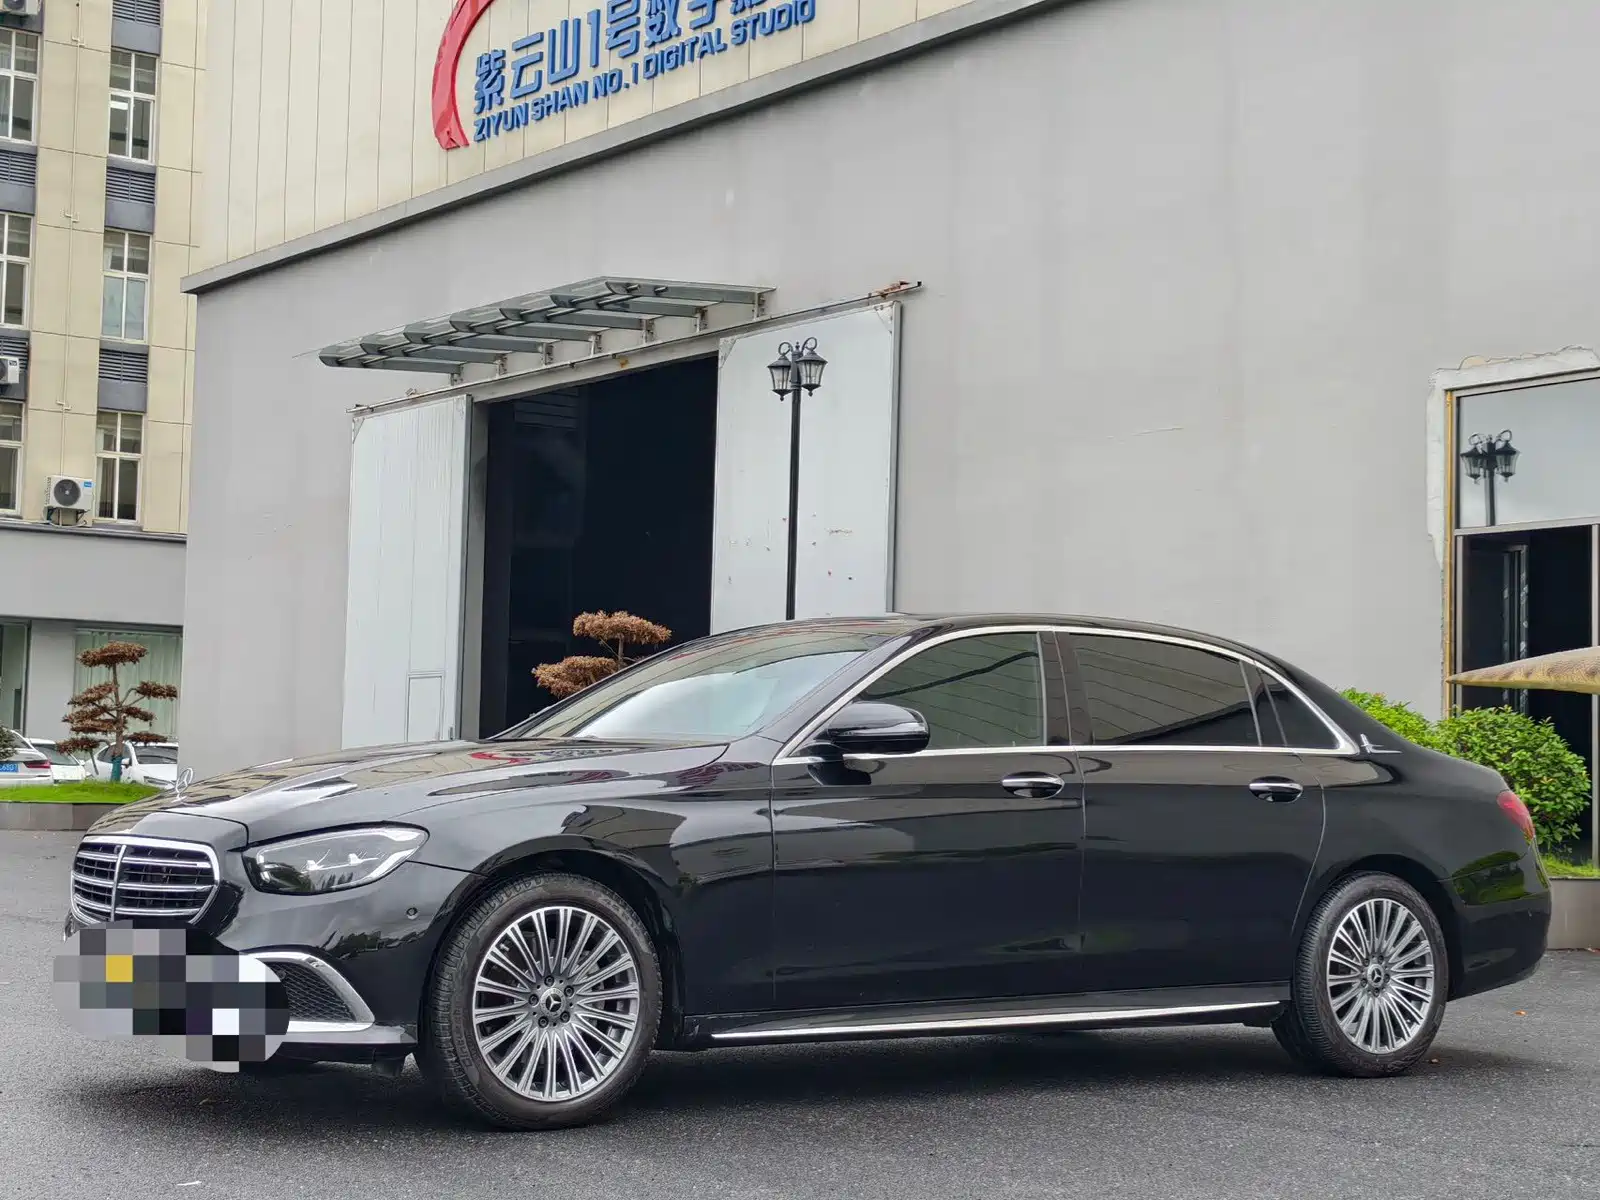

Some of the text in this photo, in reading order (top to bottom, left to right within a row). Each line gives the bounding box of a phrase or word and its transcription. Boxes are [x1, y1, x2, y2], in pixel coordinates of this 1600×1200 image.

[474, 0, 768, 114] 紫云山1号数
[474, 0, 816, 142] ZIYUN SHAN NO.1 DIGITAL STUDIO
